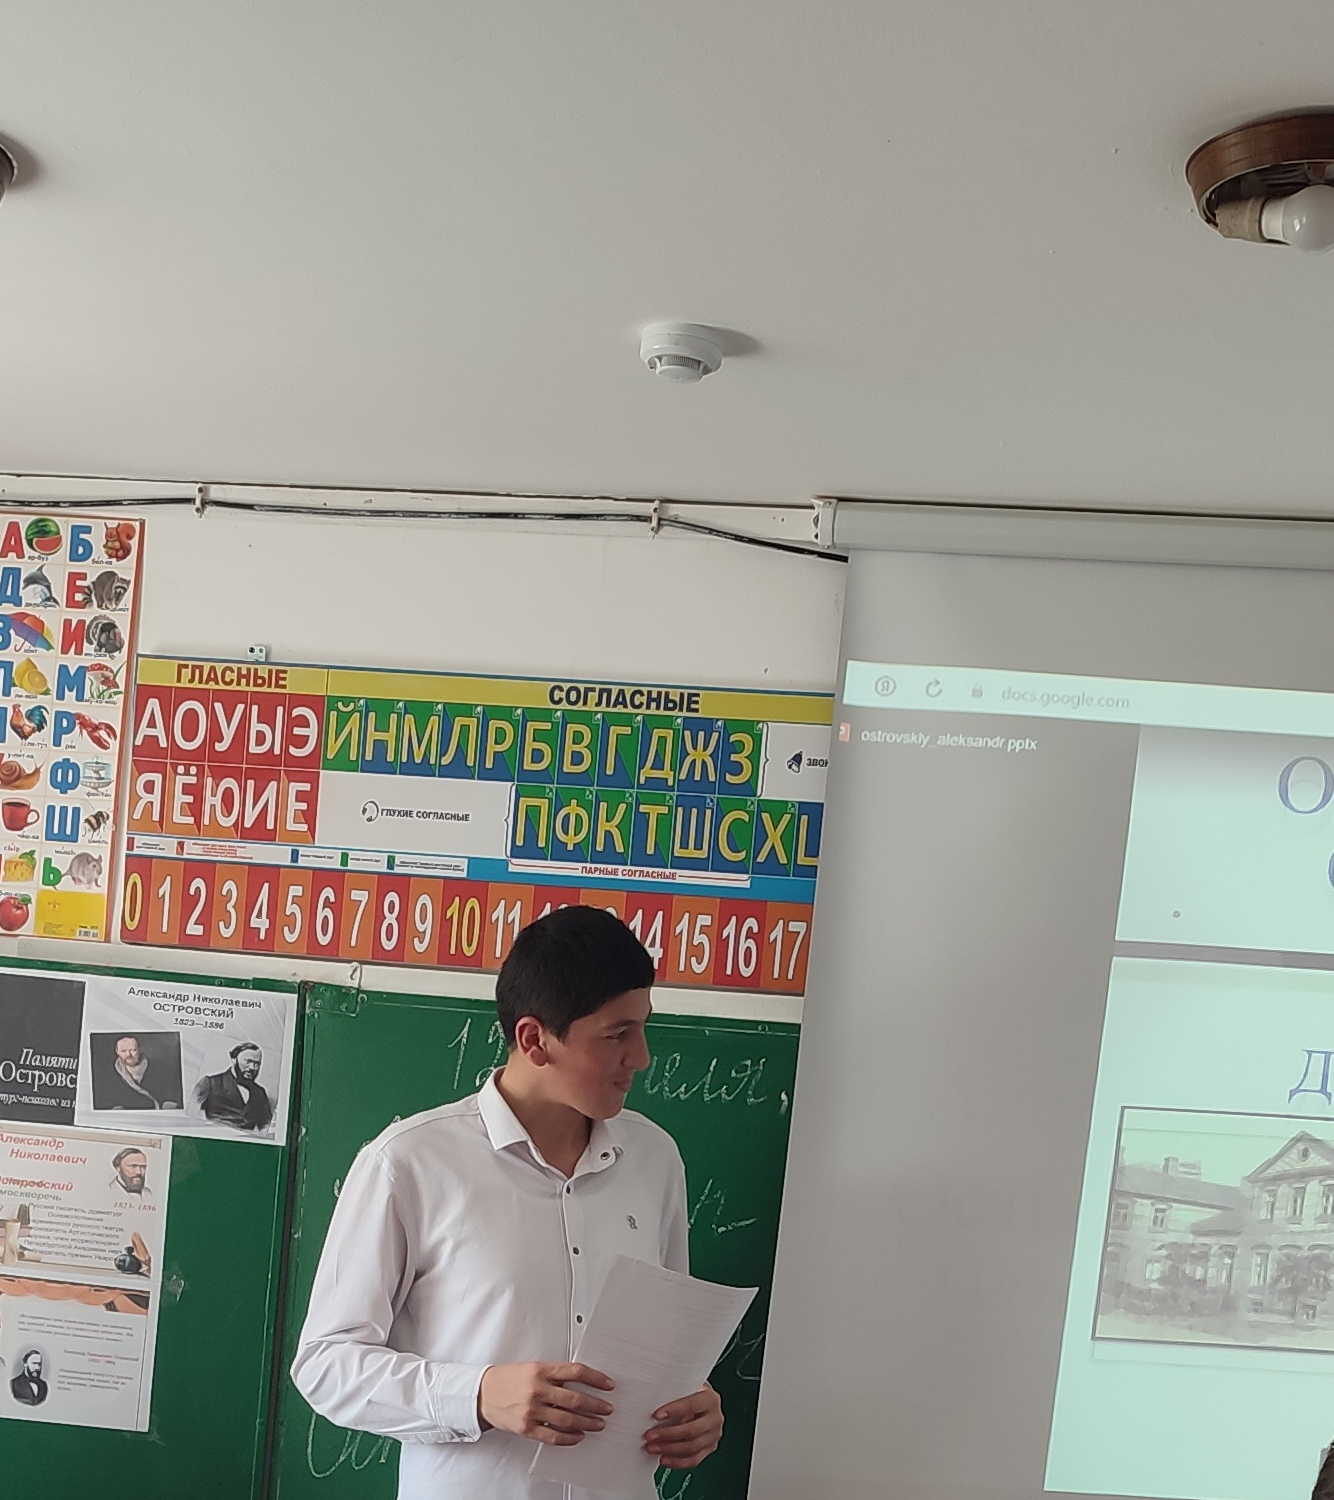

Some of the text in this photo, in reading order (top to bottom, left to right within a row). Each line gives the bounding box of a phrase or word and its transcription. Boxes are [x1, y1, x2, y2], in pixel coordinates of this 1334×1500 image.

[0, 521, 25, 559] А
[69, 525, 93, 562] Б
[66, 572, 87, 609] Е
[61, 618, 86, 655] И
[175, 663, 289, 690] ГЛАСНЫЕ
[548, 684, 702, 714] СОГЛАСНЫЕ
[1001, 686, 1131, 709] docs.google.com
[861, 730, 1038, 753] ostrovskiy_aleksandr.pptx
[50, 758, 80, 794] Ф
[380, 809, 471, 823] ГЛУХИЕ СОГЛАСНЫЕ
[580, 866, 677, 881] ПАРНЫЕ СОГЛАСНЫЕ
[124, 873, 807, 981] 0 1 2 3 4 5 6 7 8 9 10 15 16 17
[127, 986, 262, 1011] Александр Николаевич
[153, 1001, 235, 1020] ОСТРОВСКИЙ
[19, 1048, 78, 1071] Памяти
[9, 1148, 87, 1166] Николаевич
